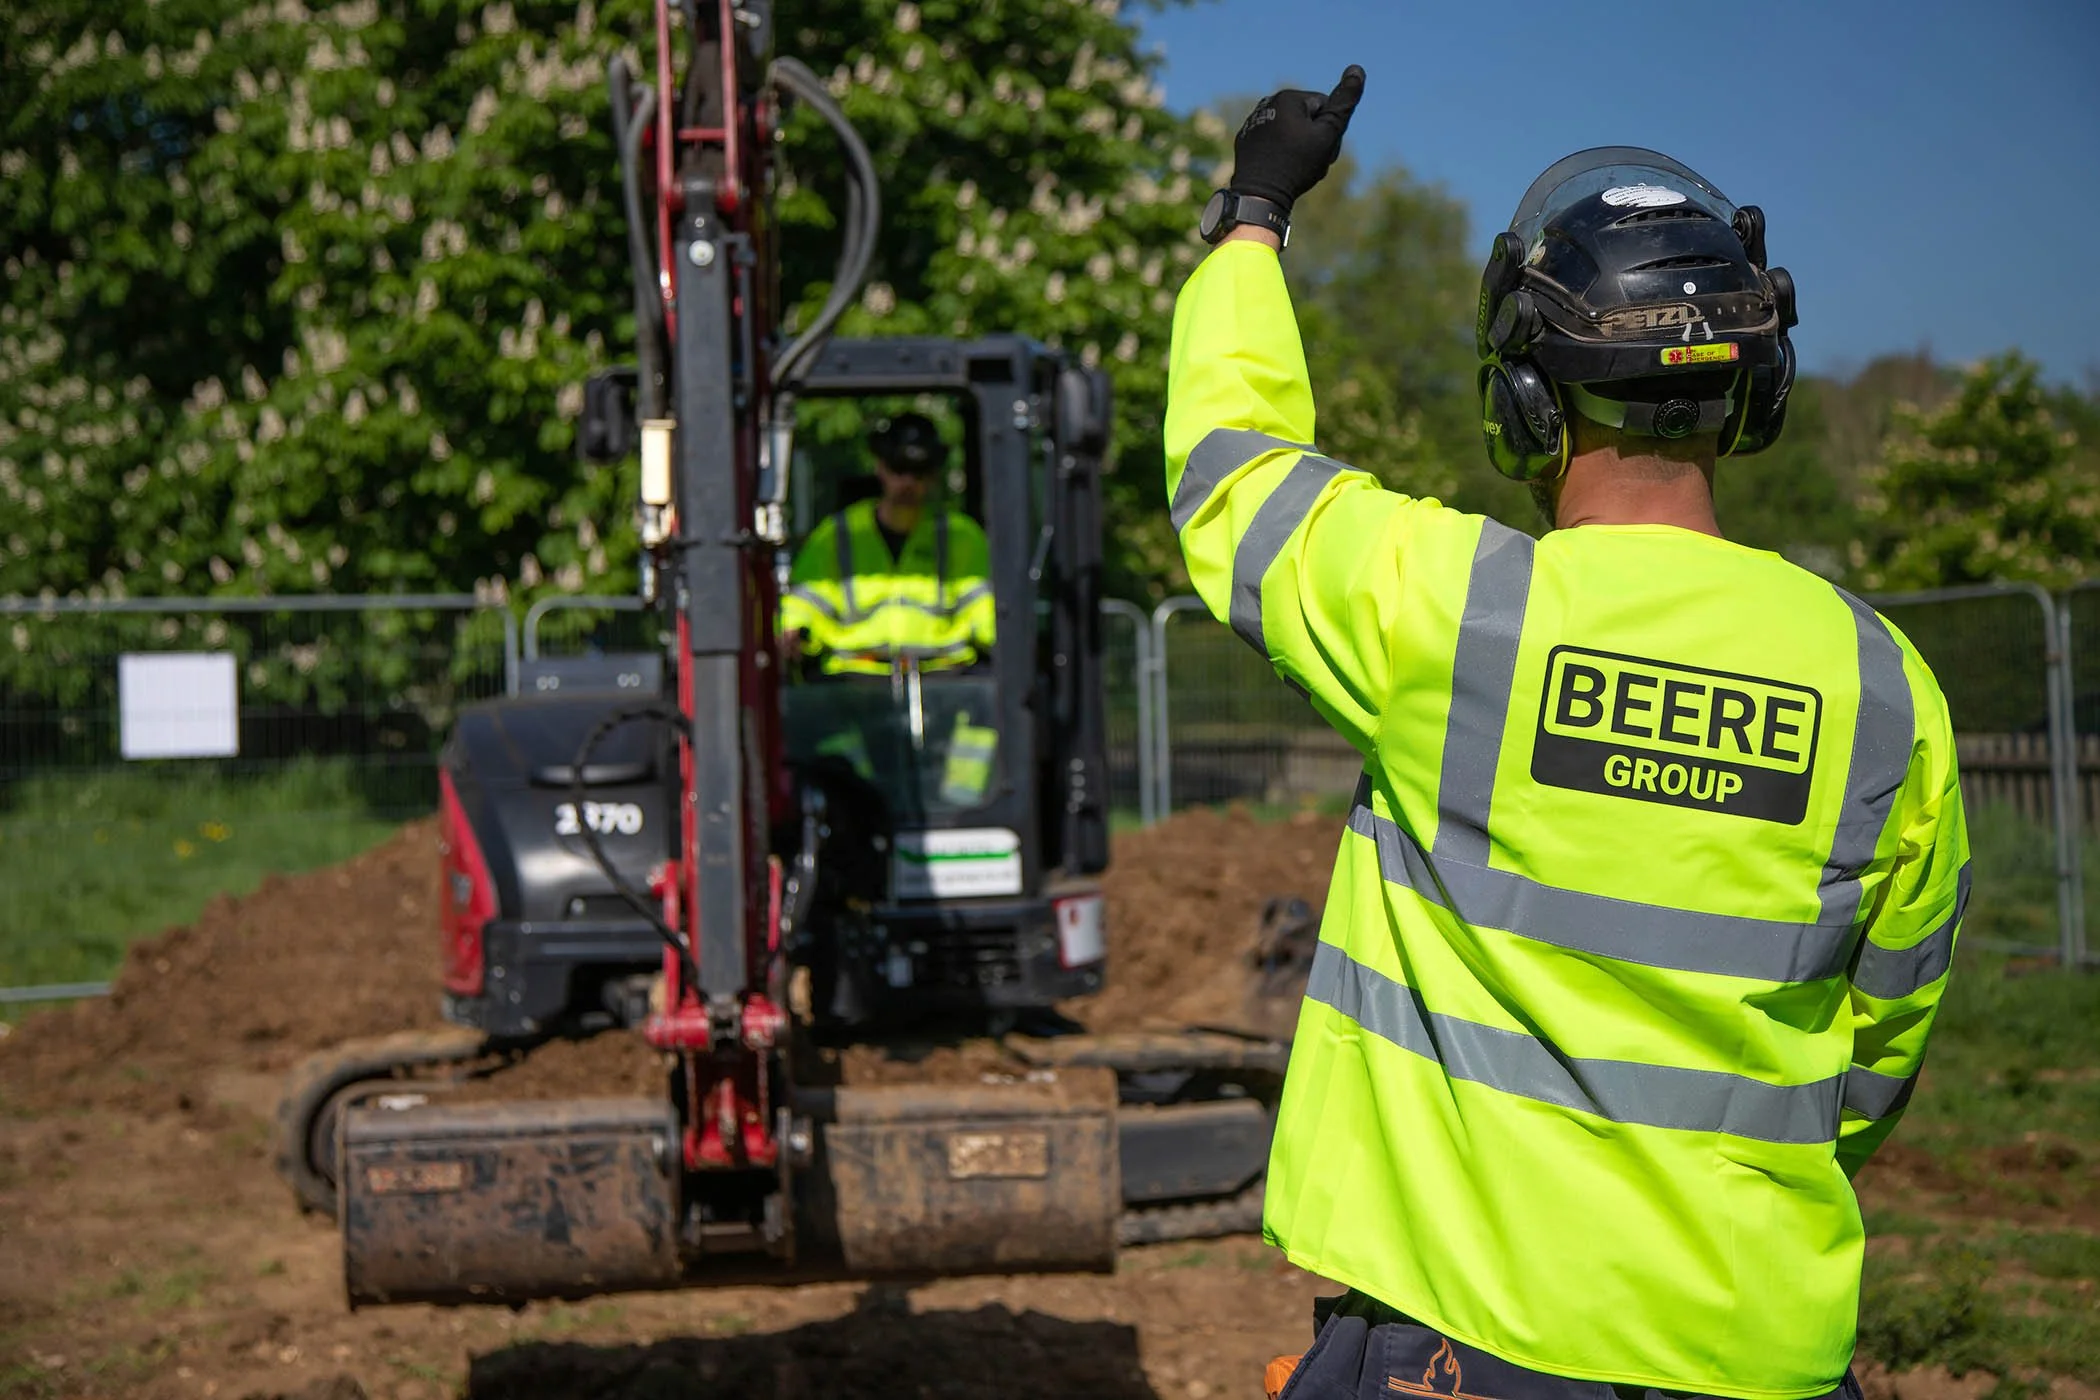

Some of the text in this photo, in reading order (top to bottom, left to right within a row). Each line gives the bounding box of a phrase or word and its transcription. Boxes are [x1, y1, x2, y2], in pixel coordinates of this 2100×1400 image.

[1601, 306, 1704, 338] PETZL
[1554, 662, 1807, 763] BEERE
[1603, 754, 1744, 803] GROUP
